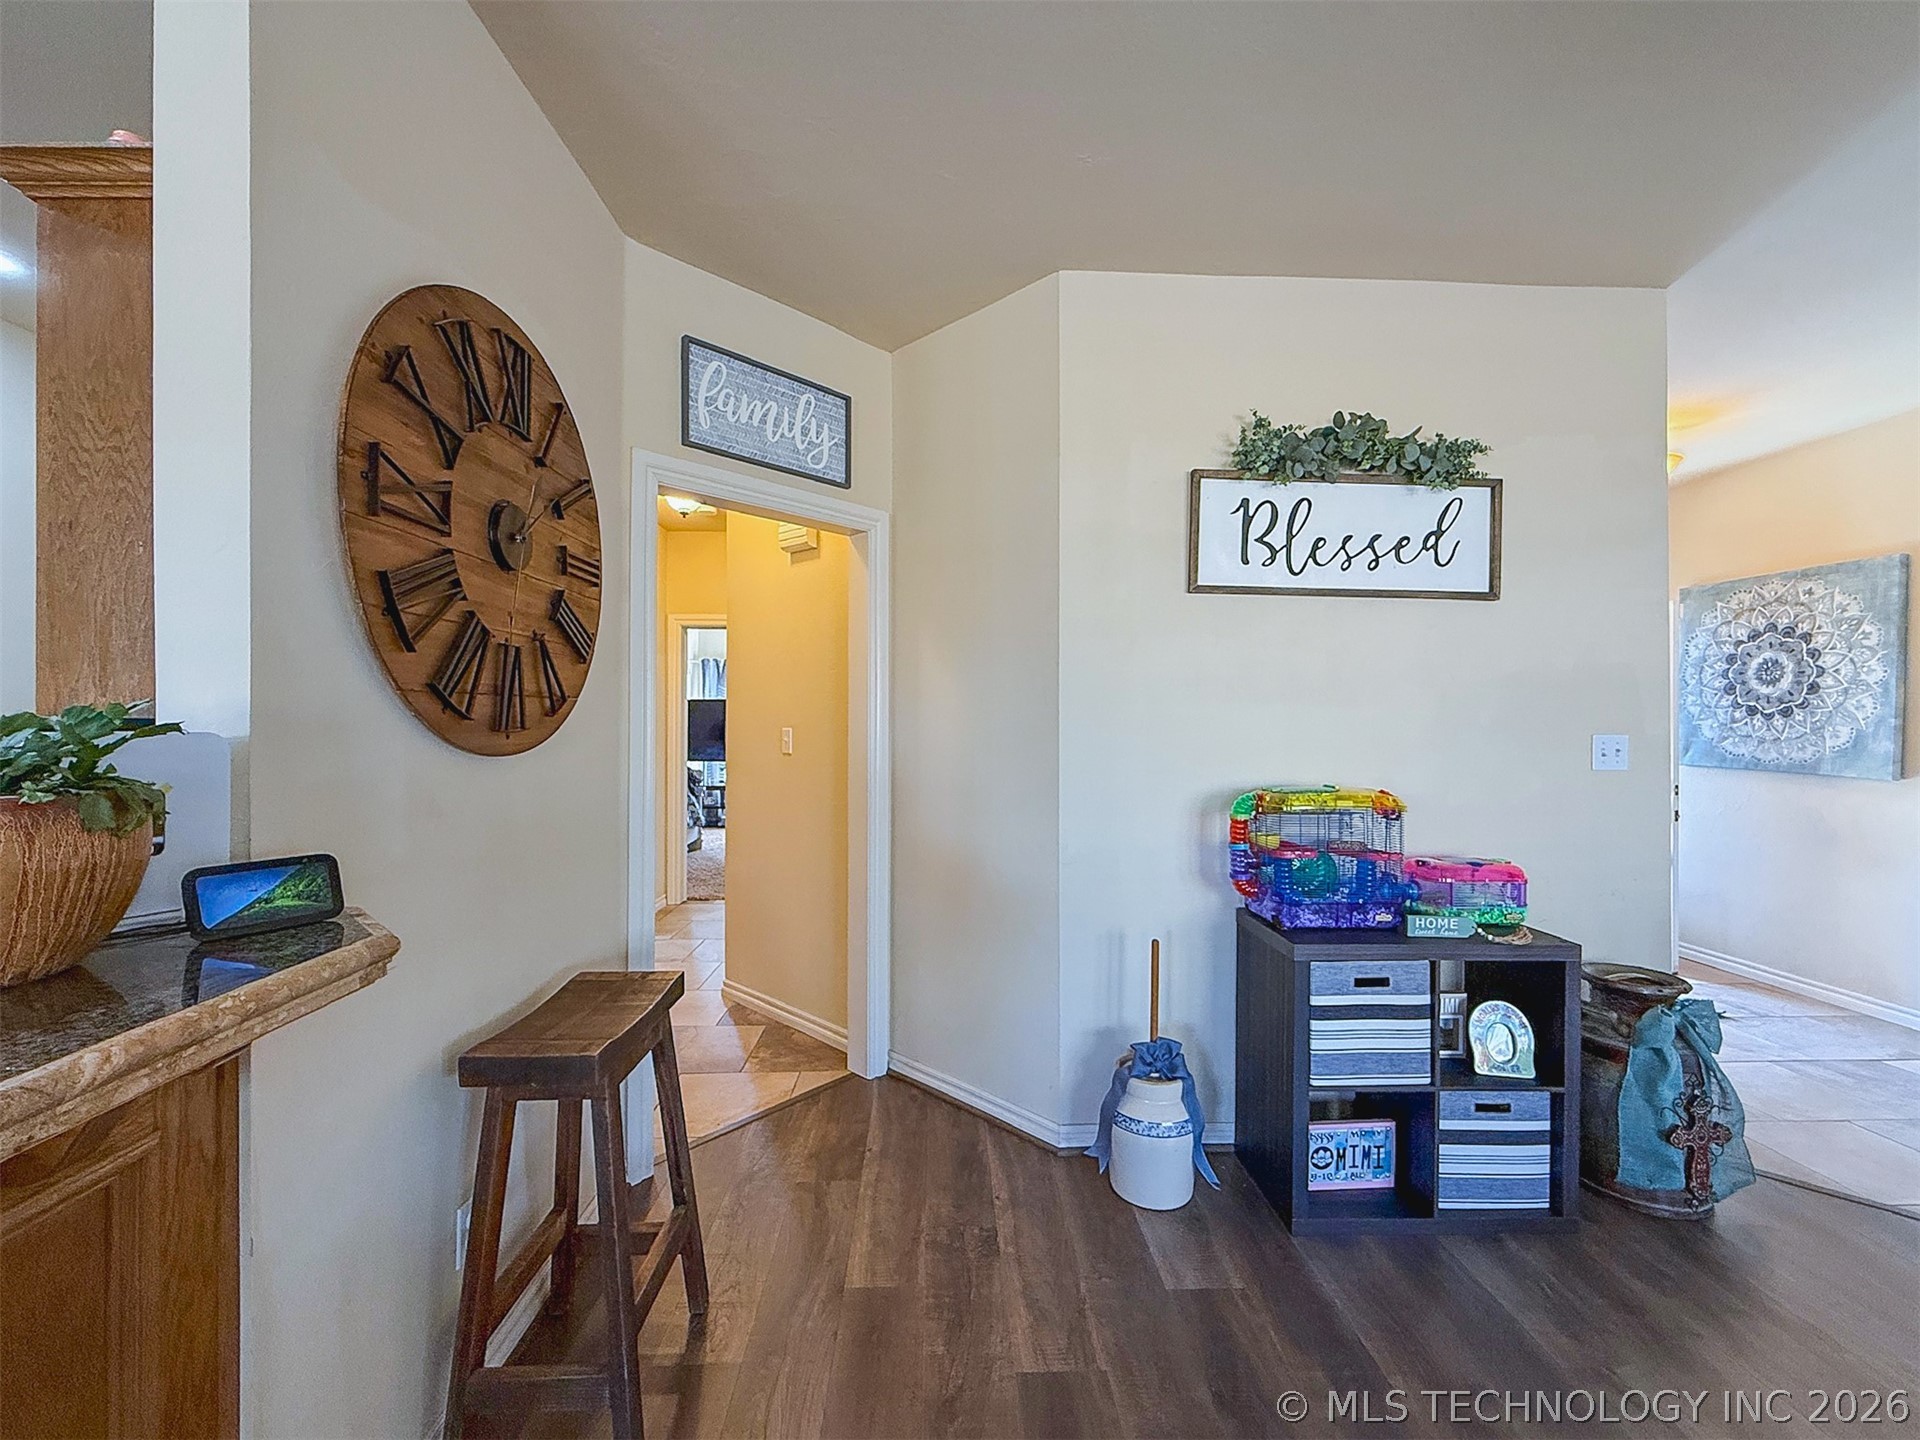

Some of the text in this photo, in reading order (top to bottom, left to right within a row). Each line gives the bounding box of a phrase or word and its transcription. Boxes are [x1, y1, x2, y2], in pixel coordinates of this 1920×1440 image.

[380, 344, 467, 470] X
[490, 326, 534, 442] XII
[698, 361, 838, 469] family
[534, 402, 565, 467] I
[556, 544, 600, 588] III
[1230, 497, 1463, 576] Blessed
[376, 547, 468, 653] VIII
[425, 609, 496, 721] VII
[491, 641, 527, 733] VI
[1415, 917, 1459, 929] HOME
[1440, 998, 1459, 1013] IMI
[1335, 1144, 1385, 1171] MIMI
